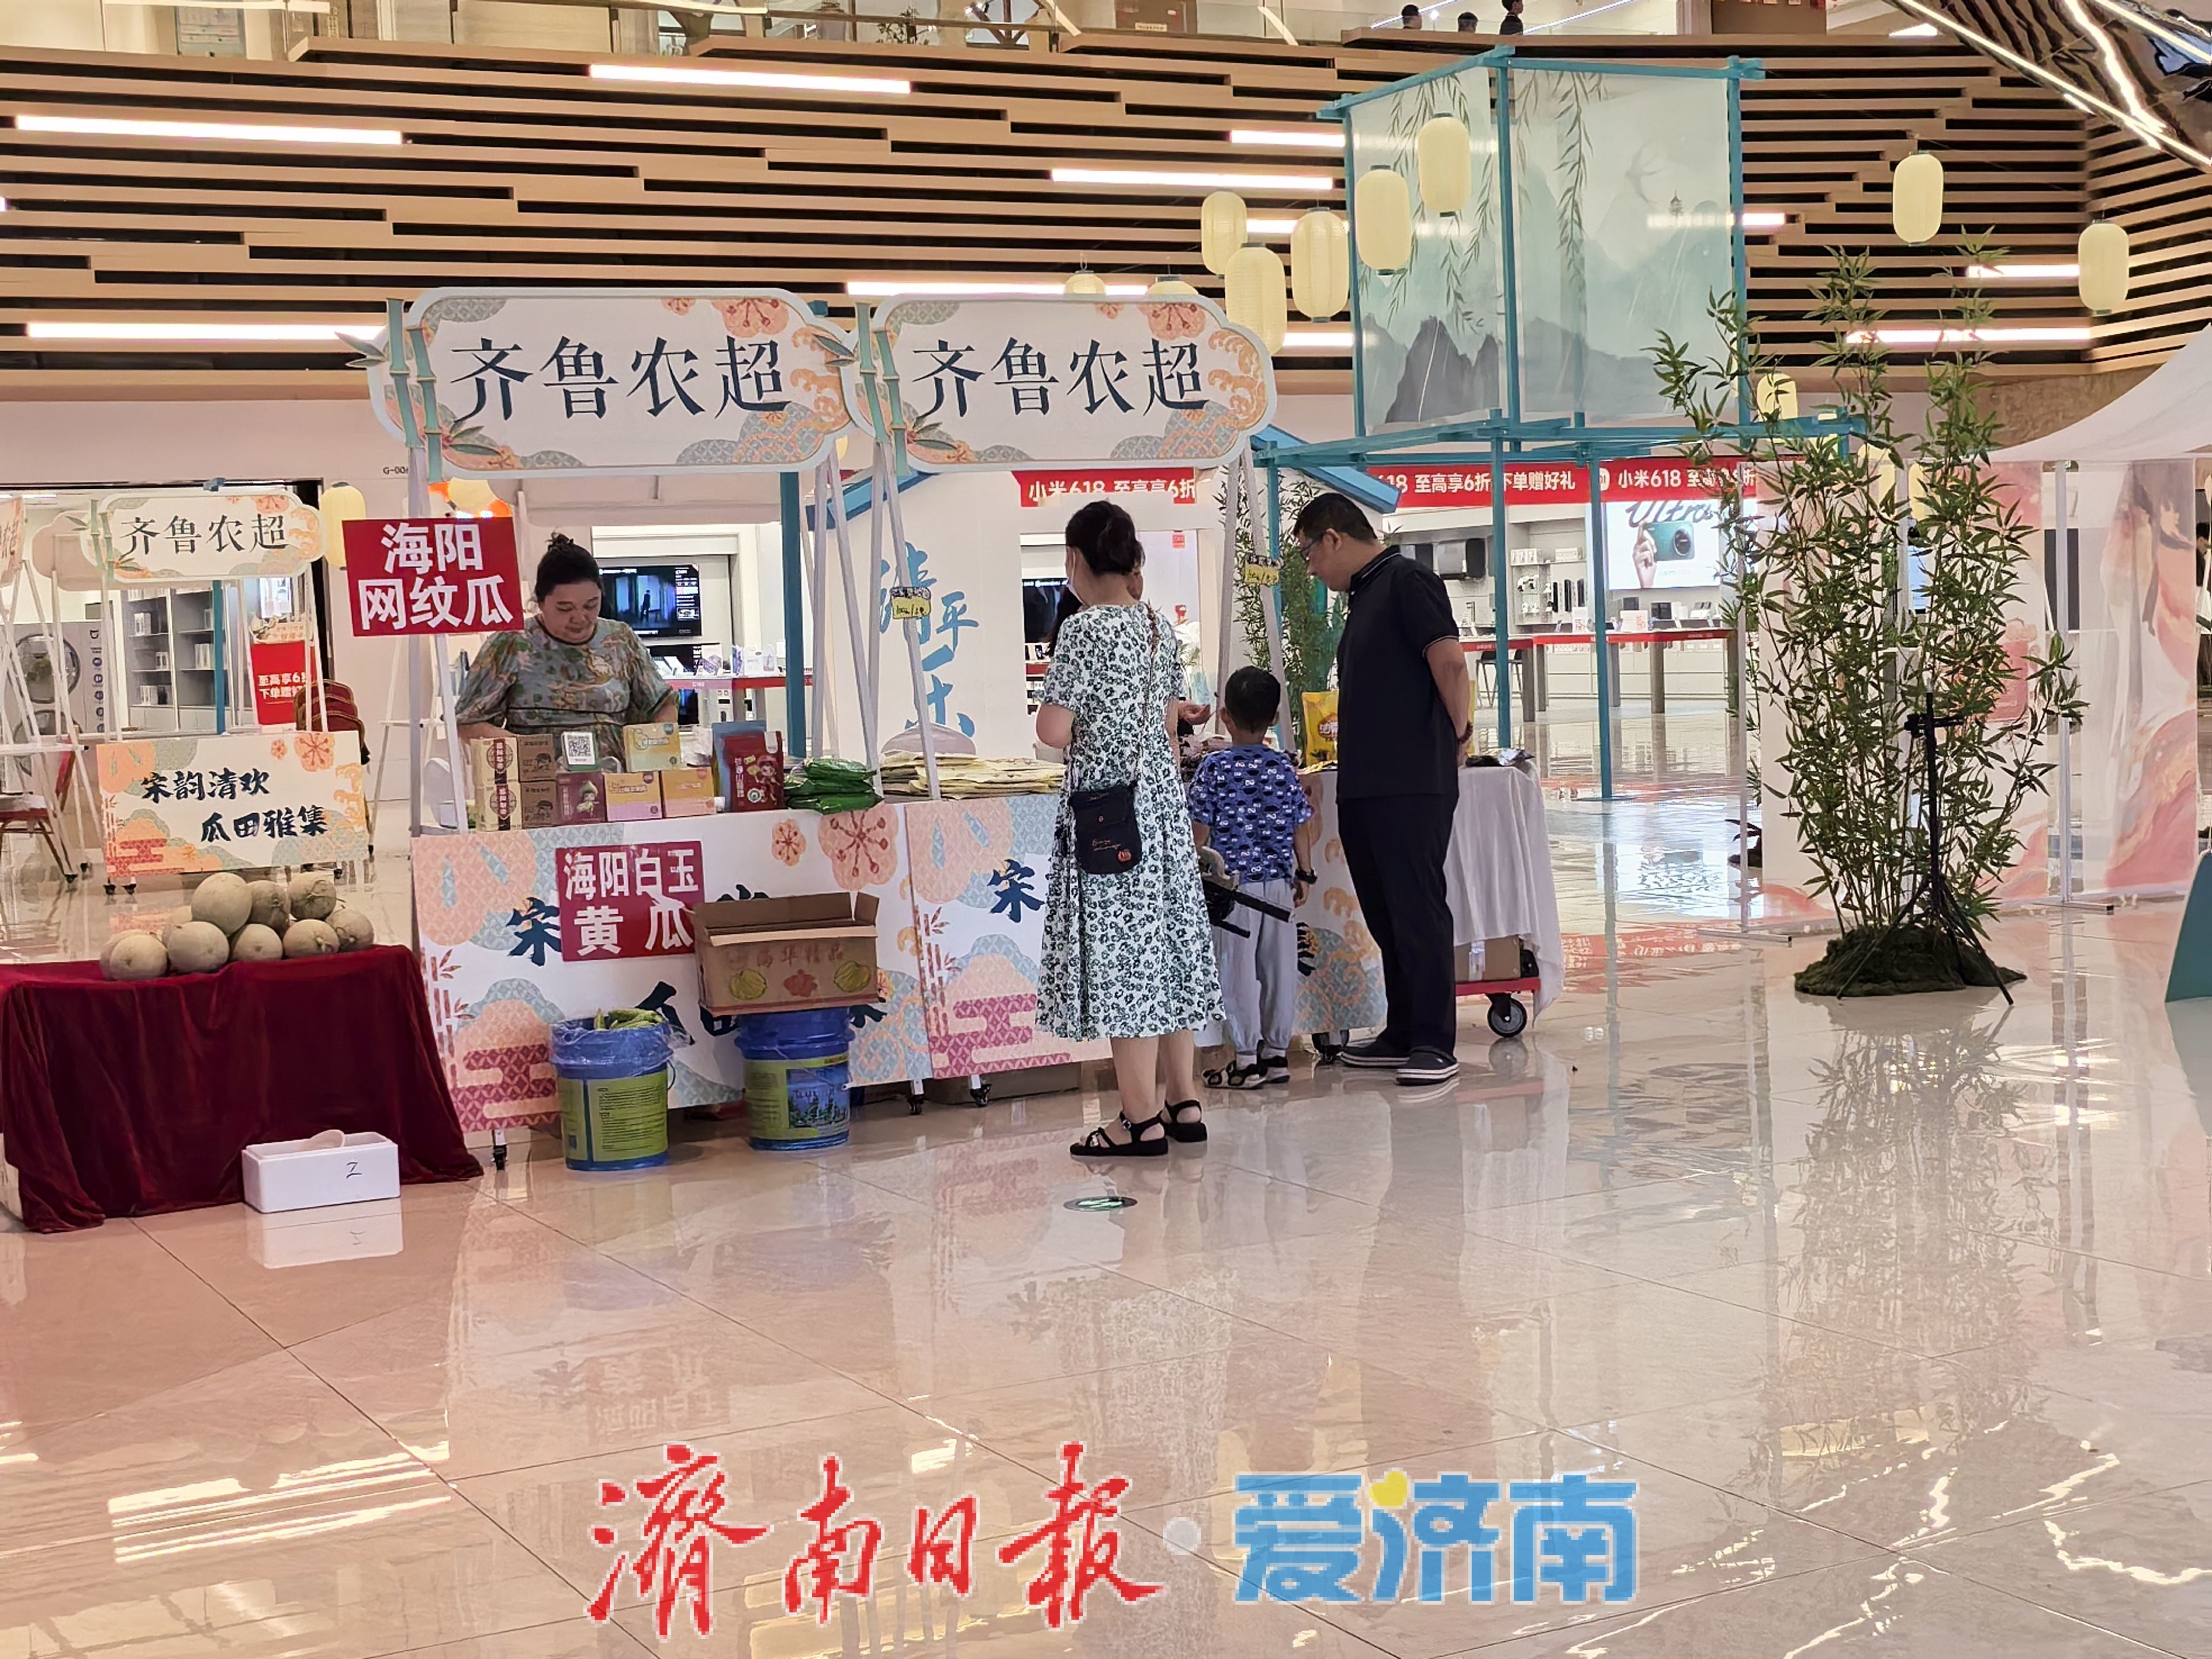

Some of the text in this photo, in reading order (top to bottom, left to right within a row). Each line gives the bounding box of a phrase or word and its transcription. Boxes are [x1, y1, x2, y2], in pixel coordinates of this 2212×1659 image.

[450, 335, 791, 422] 齐鲁农超
[913, 337, 1209, 418] 齐鲁农超
[1414, 473, 1492, 493] 至高享6折
[1618, 469, 1681, 488] 小米618
[119, 514, 289, 561] 齐鲁农超
[381, 522, 483, 575] 海阳
[358, 575, 514, 630] 网纹瓜
[141, 767, 270, 804] 宋韵清欢
[200, 804, 328, 843] 瓜田雅集
[563, 848, 699, 901] 海阳白玉
[574, 901, 694, 956] 黄瓜
